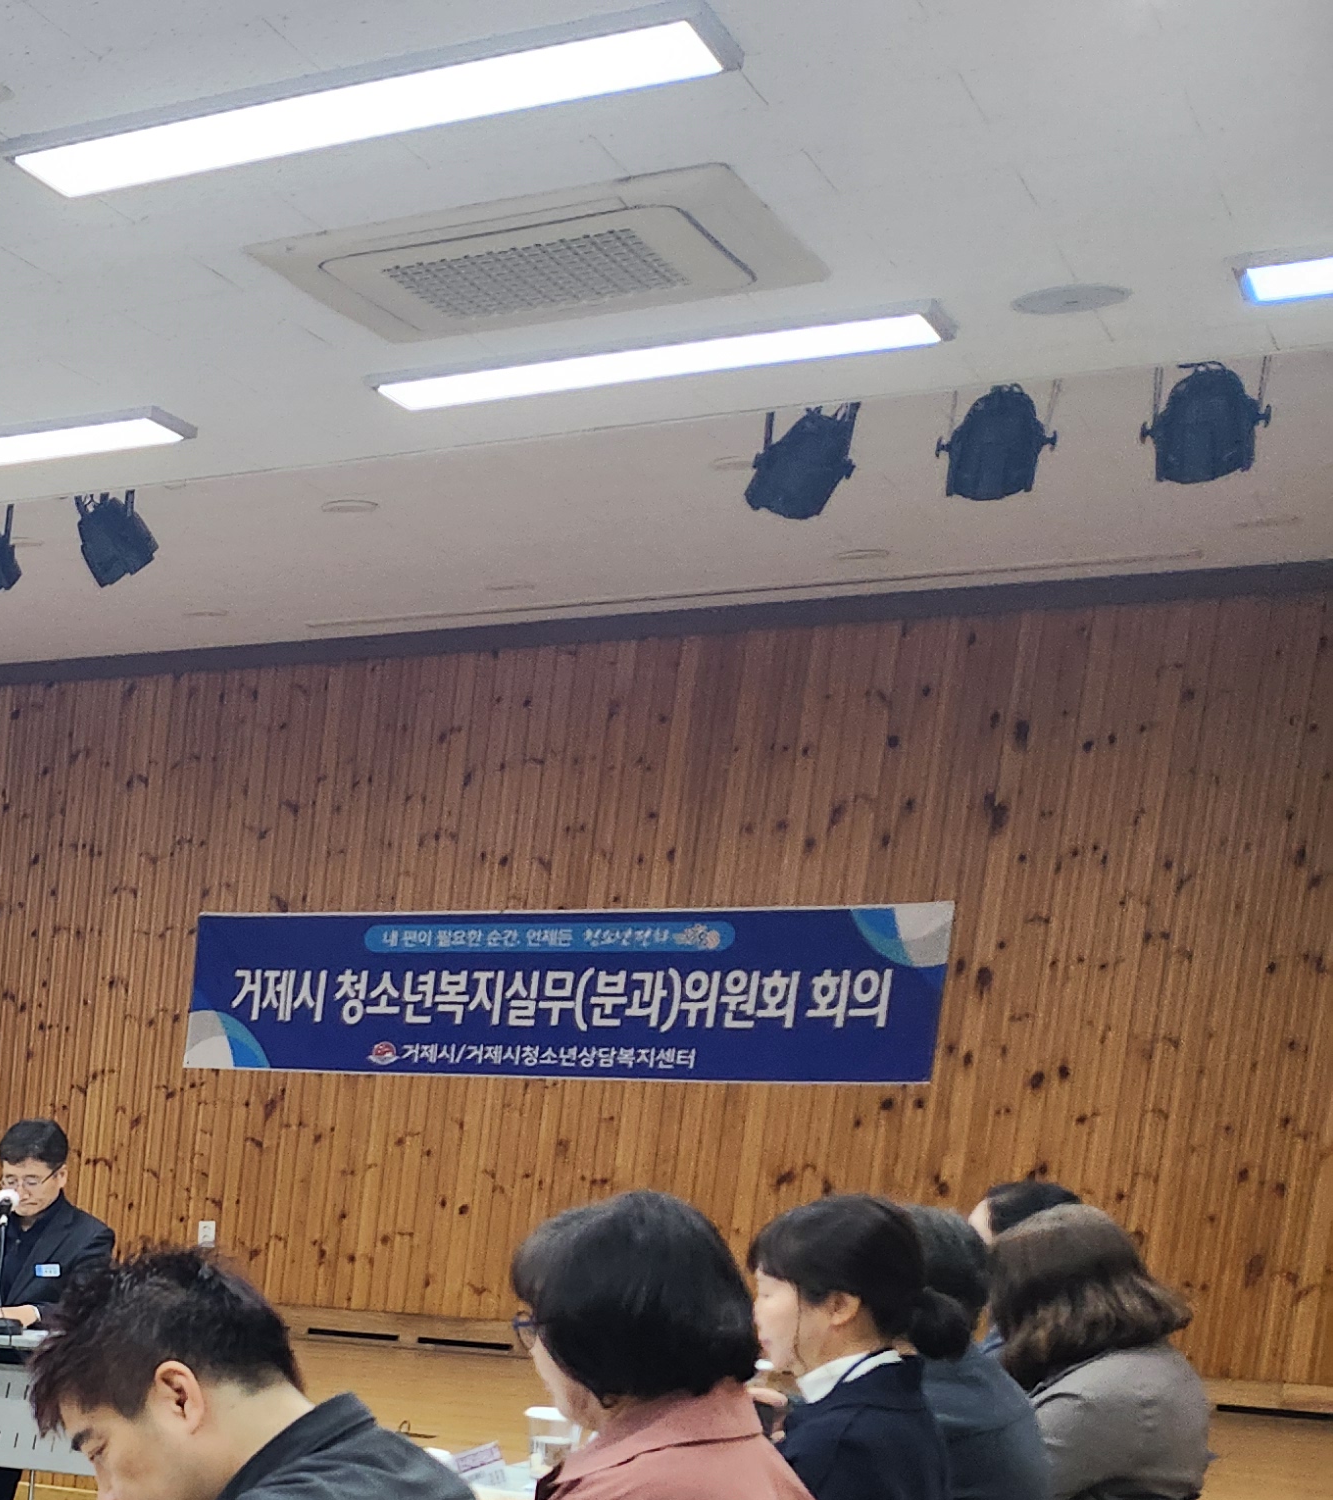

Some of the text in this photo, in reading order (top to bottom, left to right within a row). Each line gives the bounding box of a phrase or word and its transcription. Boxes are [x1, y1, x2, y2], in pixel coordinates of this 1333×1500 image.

[383, 929, 398, 947] 내
[402, 929, 432, 948] 편이
[437, 929, 483, 948] 필요한
[526, 929, 573, 947] 언제든
[232, 967, 893, 1033] 거제시 청소년복지실무(분과)위원회 회의
